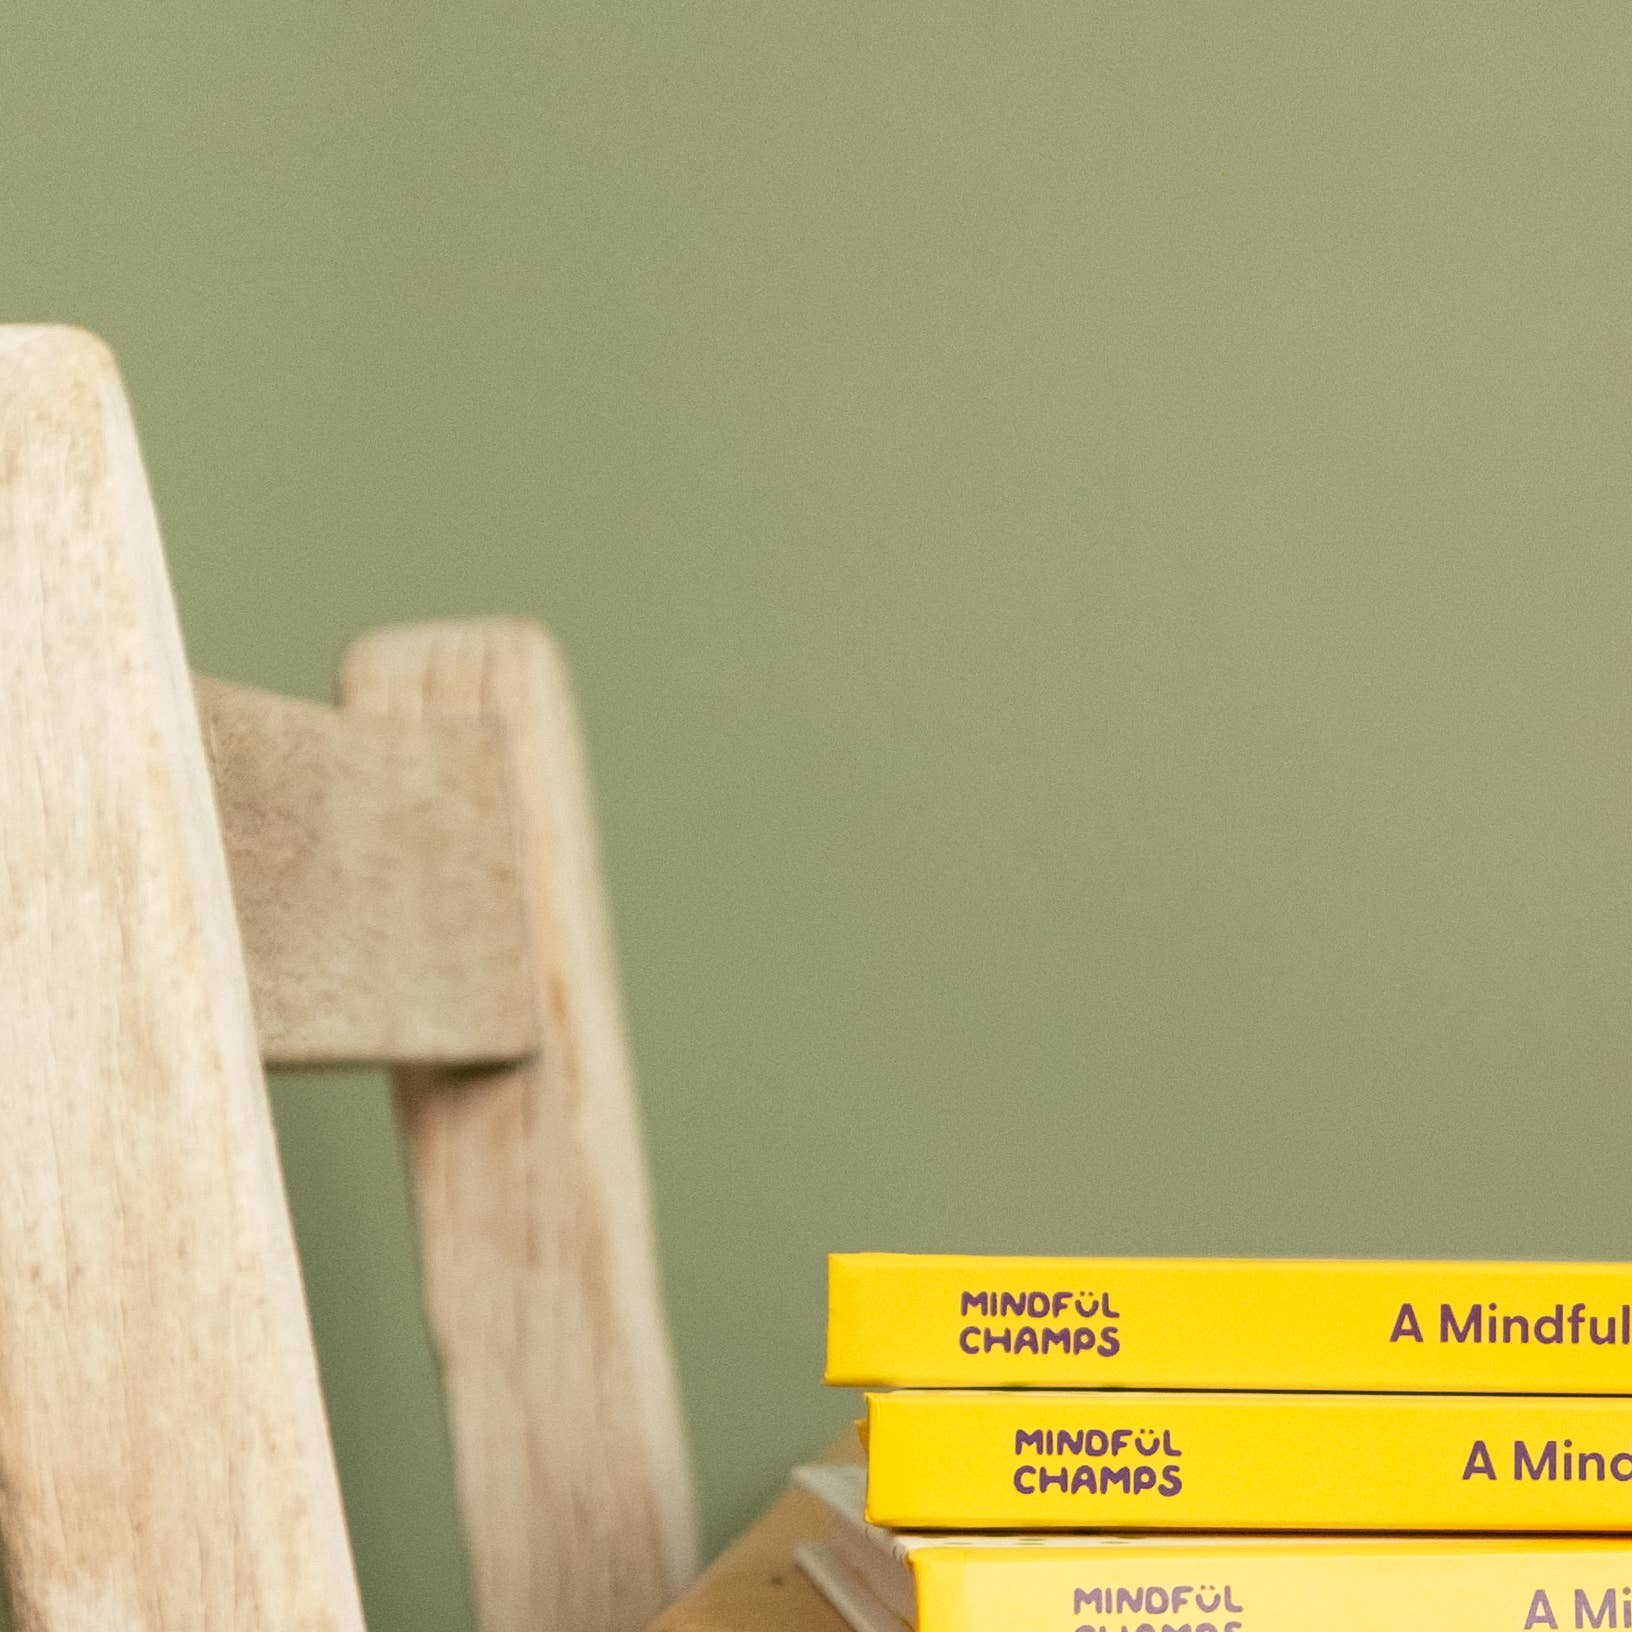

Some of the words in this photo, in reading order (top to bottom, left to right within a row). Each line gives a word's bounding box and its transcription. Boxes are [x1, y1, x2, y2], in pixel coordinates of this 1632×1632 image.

[958, 1325, 1121, 1358] CHAMPS
[1390, 1303, 1424, 1343] A
[1012, 1462, 1183, 1498] CHAMPS
[1462, 1439, 1497, 1481] A
[1521, 1587, 1560, 1632] A
